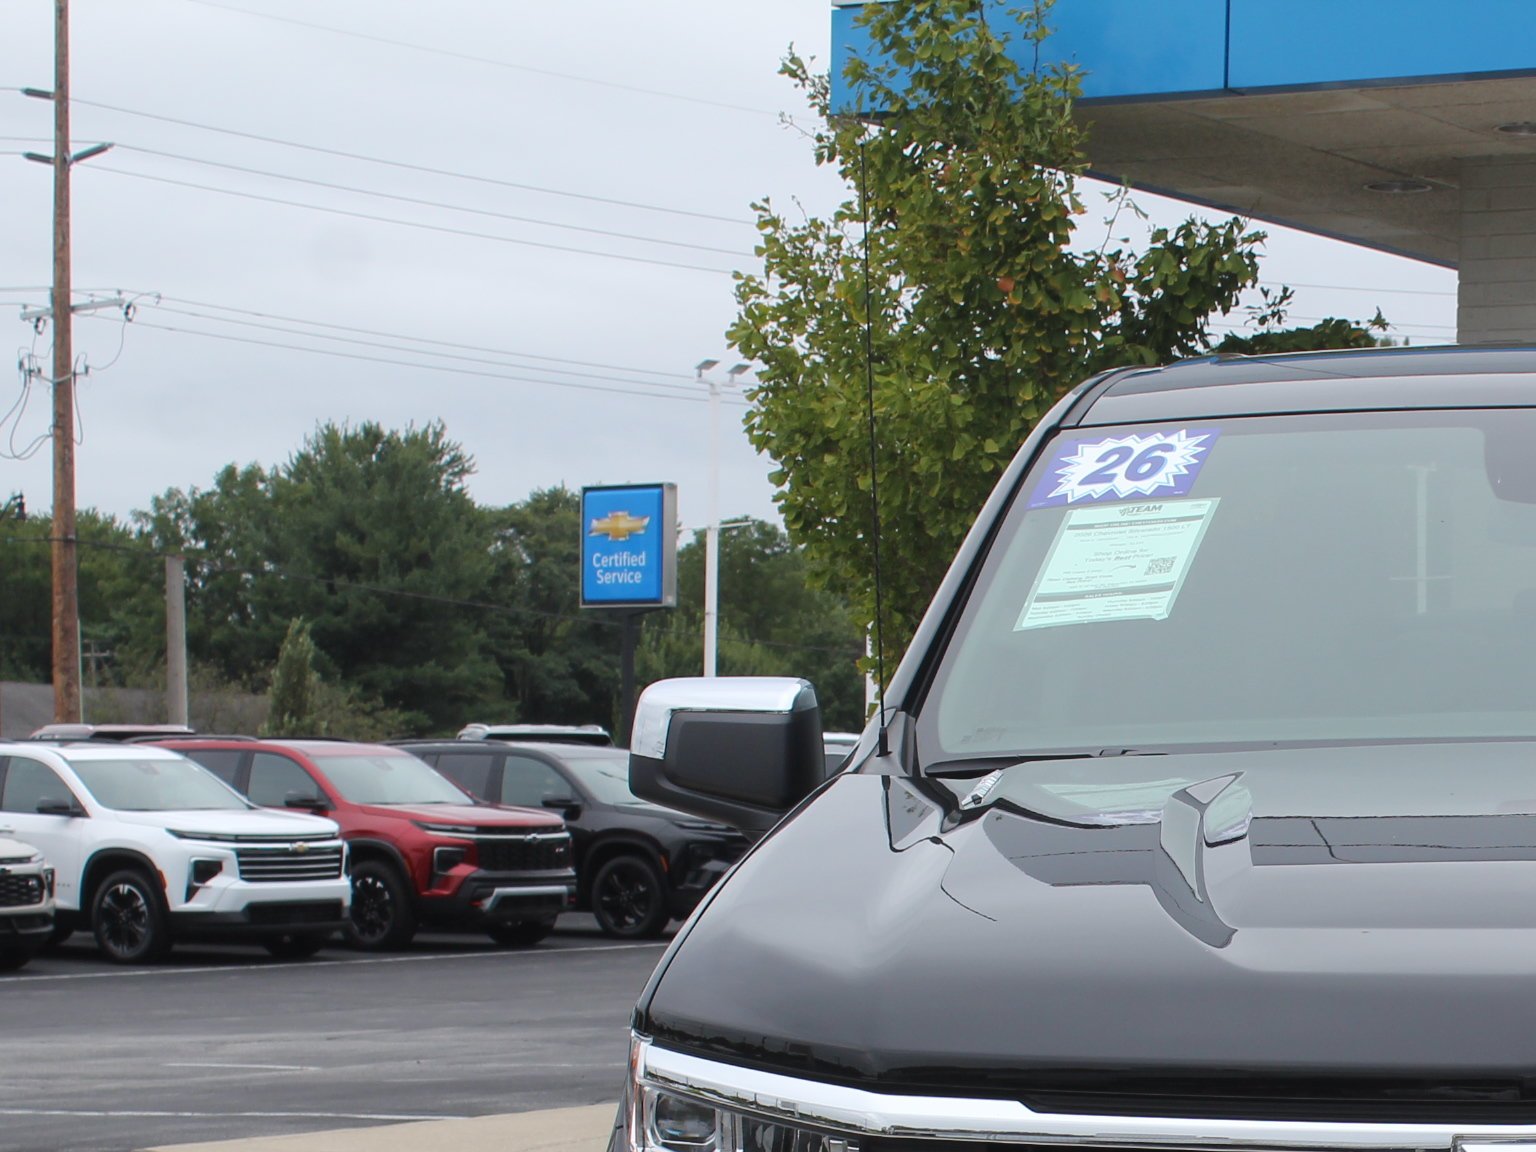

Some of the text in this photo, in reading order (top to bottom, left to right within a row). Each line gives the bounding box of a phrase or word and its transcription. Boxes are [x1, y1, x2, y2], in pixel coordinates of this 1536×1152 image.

[1077, 443, 1177, 486] 26
[592, 551, 647, 568] Certified
[596, 569, 642, 584] Service
